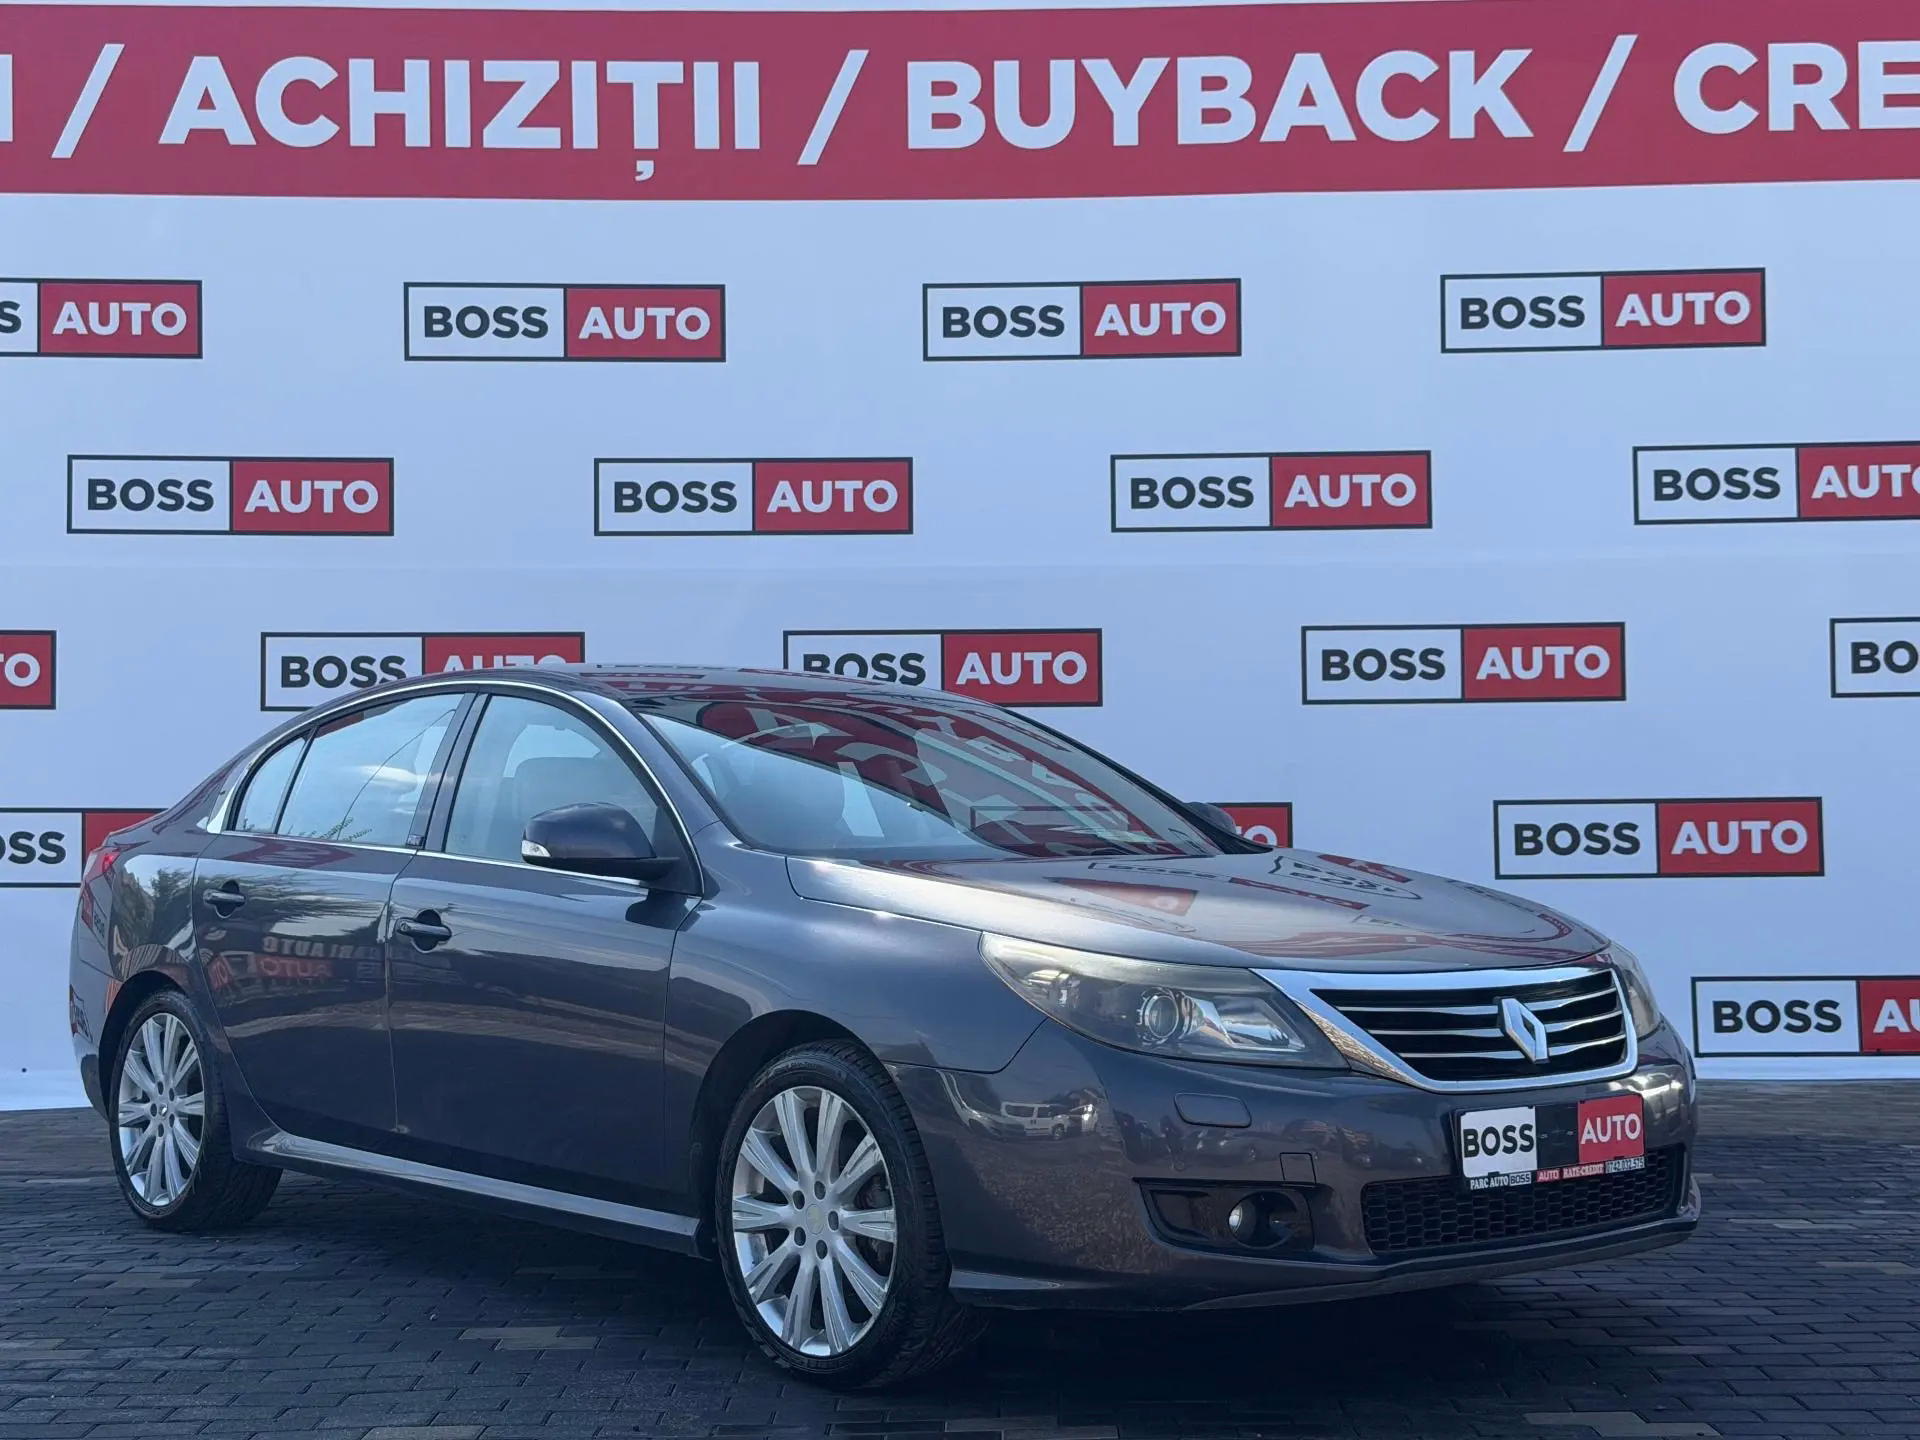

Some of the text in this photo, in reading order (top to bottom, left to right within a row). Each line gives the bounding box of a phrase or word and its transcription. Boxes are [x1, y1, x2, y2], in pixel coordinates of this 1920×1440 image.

[159, 56, 759, 180] ACHIZIȚII
[908, 49, 1533, 149] BUYBACK
[1674, 41, 1920, 134] CRE
[53, 302, 186, 335] AUTO
[425, 306, 710, 339] BOSS AUTO
[943, 302, 1225, 338] BOSS AUTO
[1461, 291, 1750, 329] BOSS AUTO
[88, 479, 378, 513] BOSS AUTO
[615, 480, 897, 513] BOSS AUTO
[1131, 474, 1416, 509] BOSS AUTO
[1654, 465, 1920, 501] BOSS AUT
[281, 655, 407, 688] BOSS
[803, 652, 1086, 686] BOSS AUTO
[1322, 646, 1609, 681] BOSS AUTO
[0, 832, 66, 864] SS
[1515, 821, 1806, 855] BOSS AUTO
[1713, 1000, 1841, 1033] BOSS
[1463, 1113, 1641, 1158] BOSS AUTO
[1470, 1178, 1489, 1190] PARC
[1489, 1175, 1509, 1188] AUTO
[1510, 1174, 1530, 1185] BOSS
[1538, 1170, 1560, 1181] AUTO
